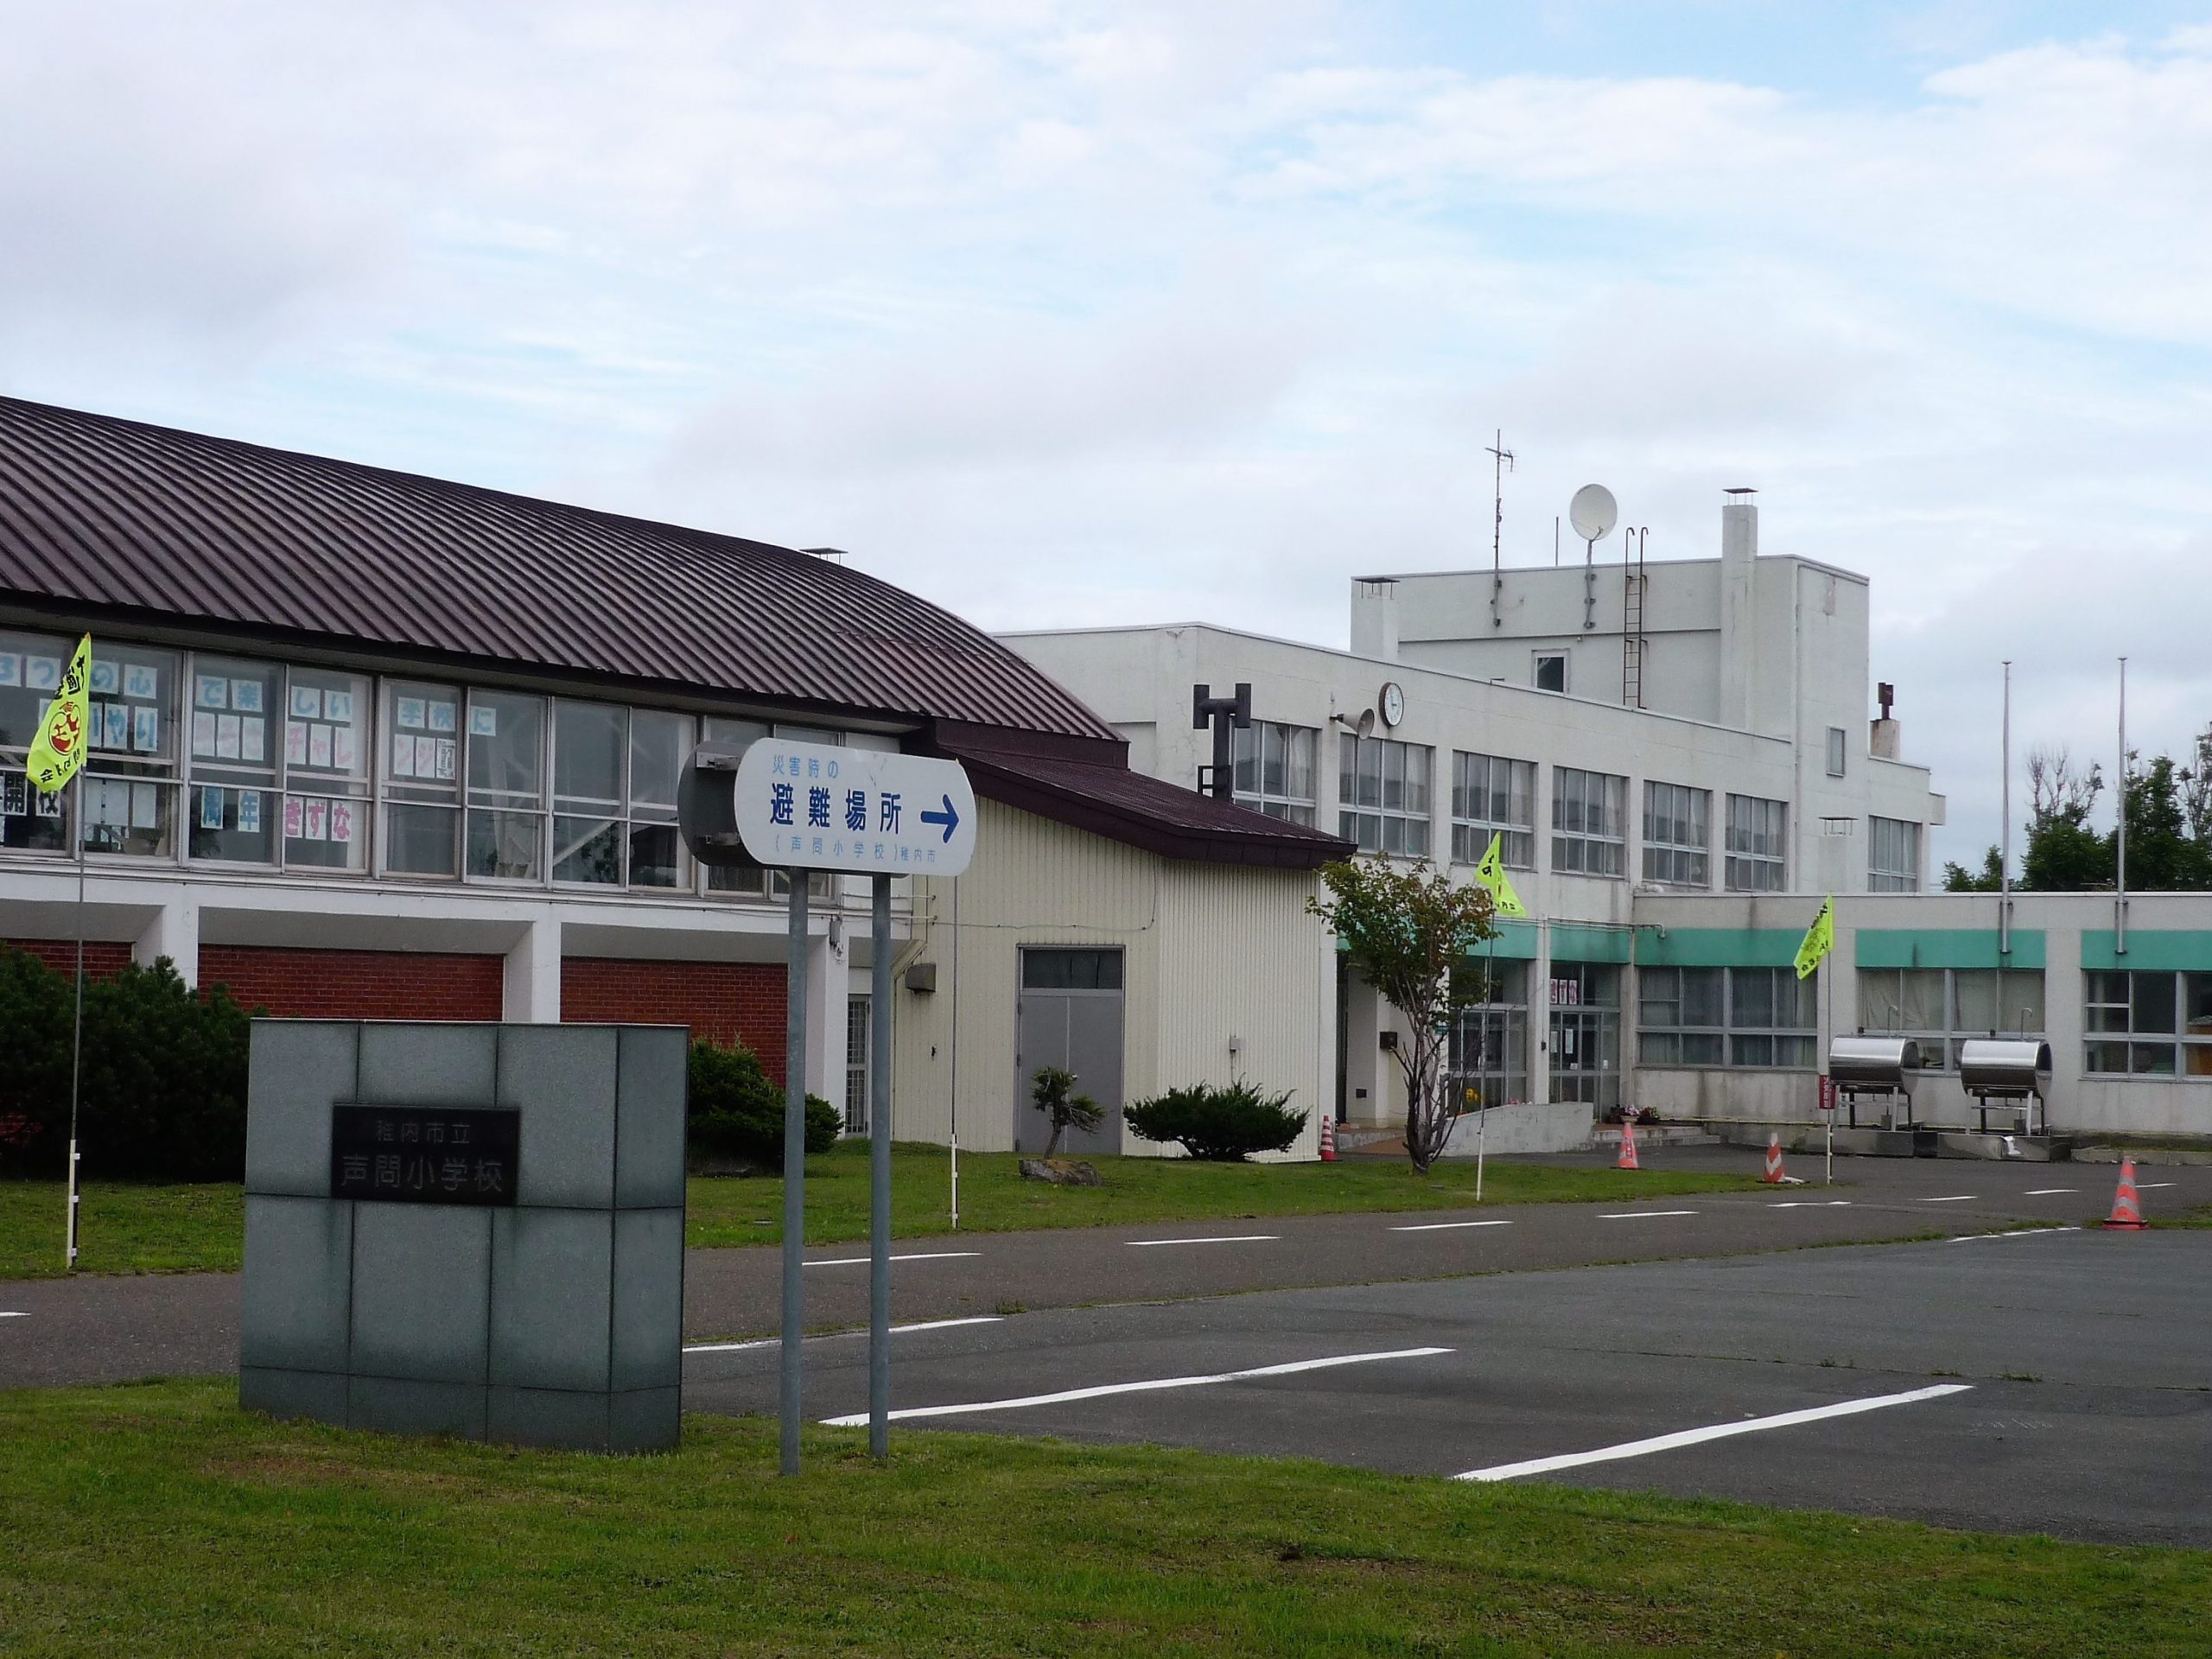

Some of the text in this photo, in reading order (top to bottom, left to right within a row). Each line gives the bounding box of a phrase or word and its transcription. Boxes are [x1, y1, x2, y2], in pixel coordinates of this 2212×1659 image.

[772, 754, 838, 779] 災害時の
[286, 798, 350, 840] きずな
[770, 782, 902, 835] 避難場所
[376, 1120, 470, 1144] 稚内市立
[341, 1154, 502, 1192] 声問小学校
